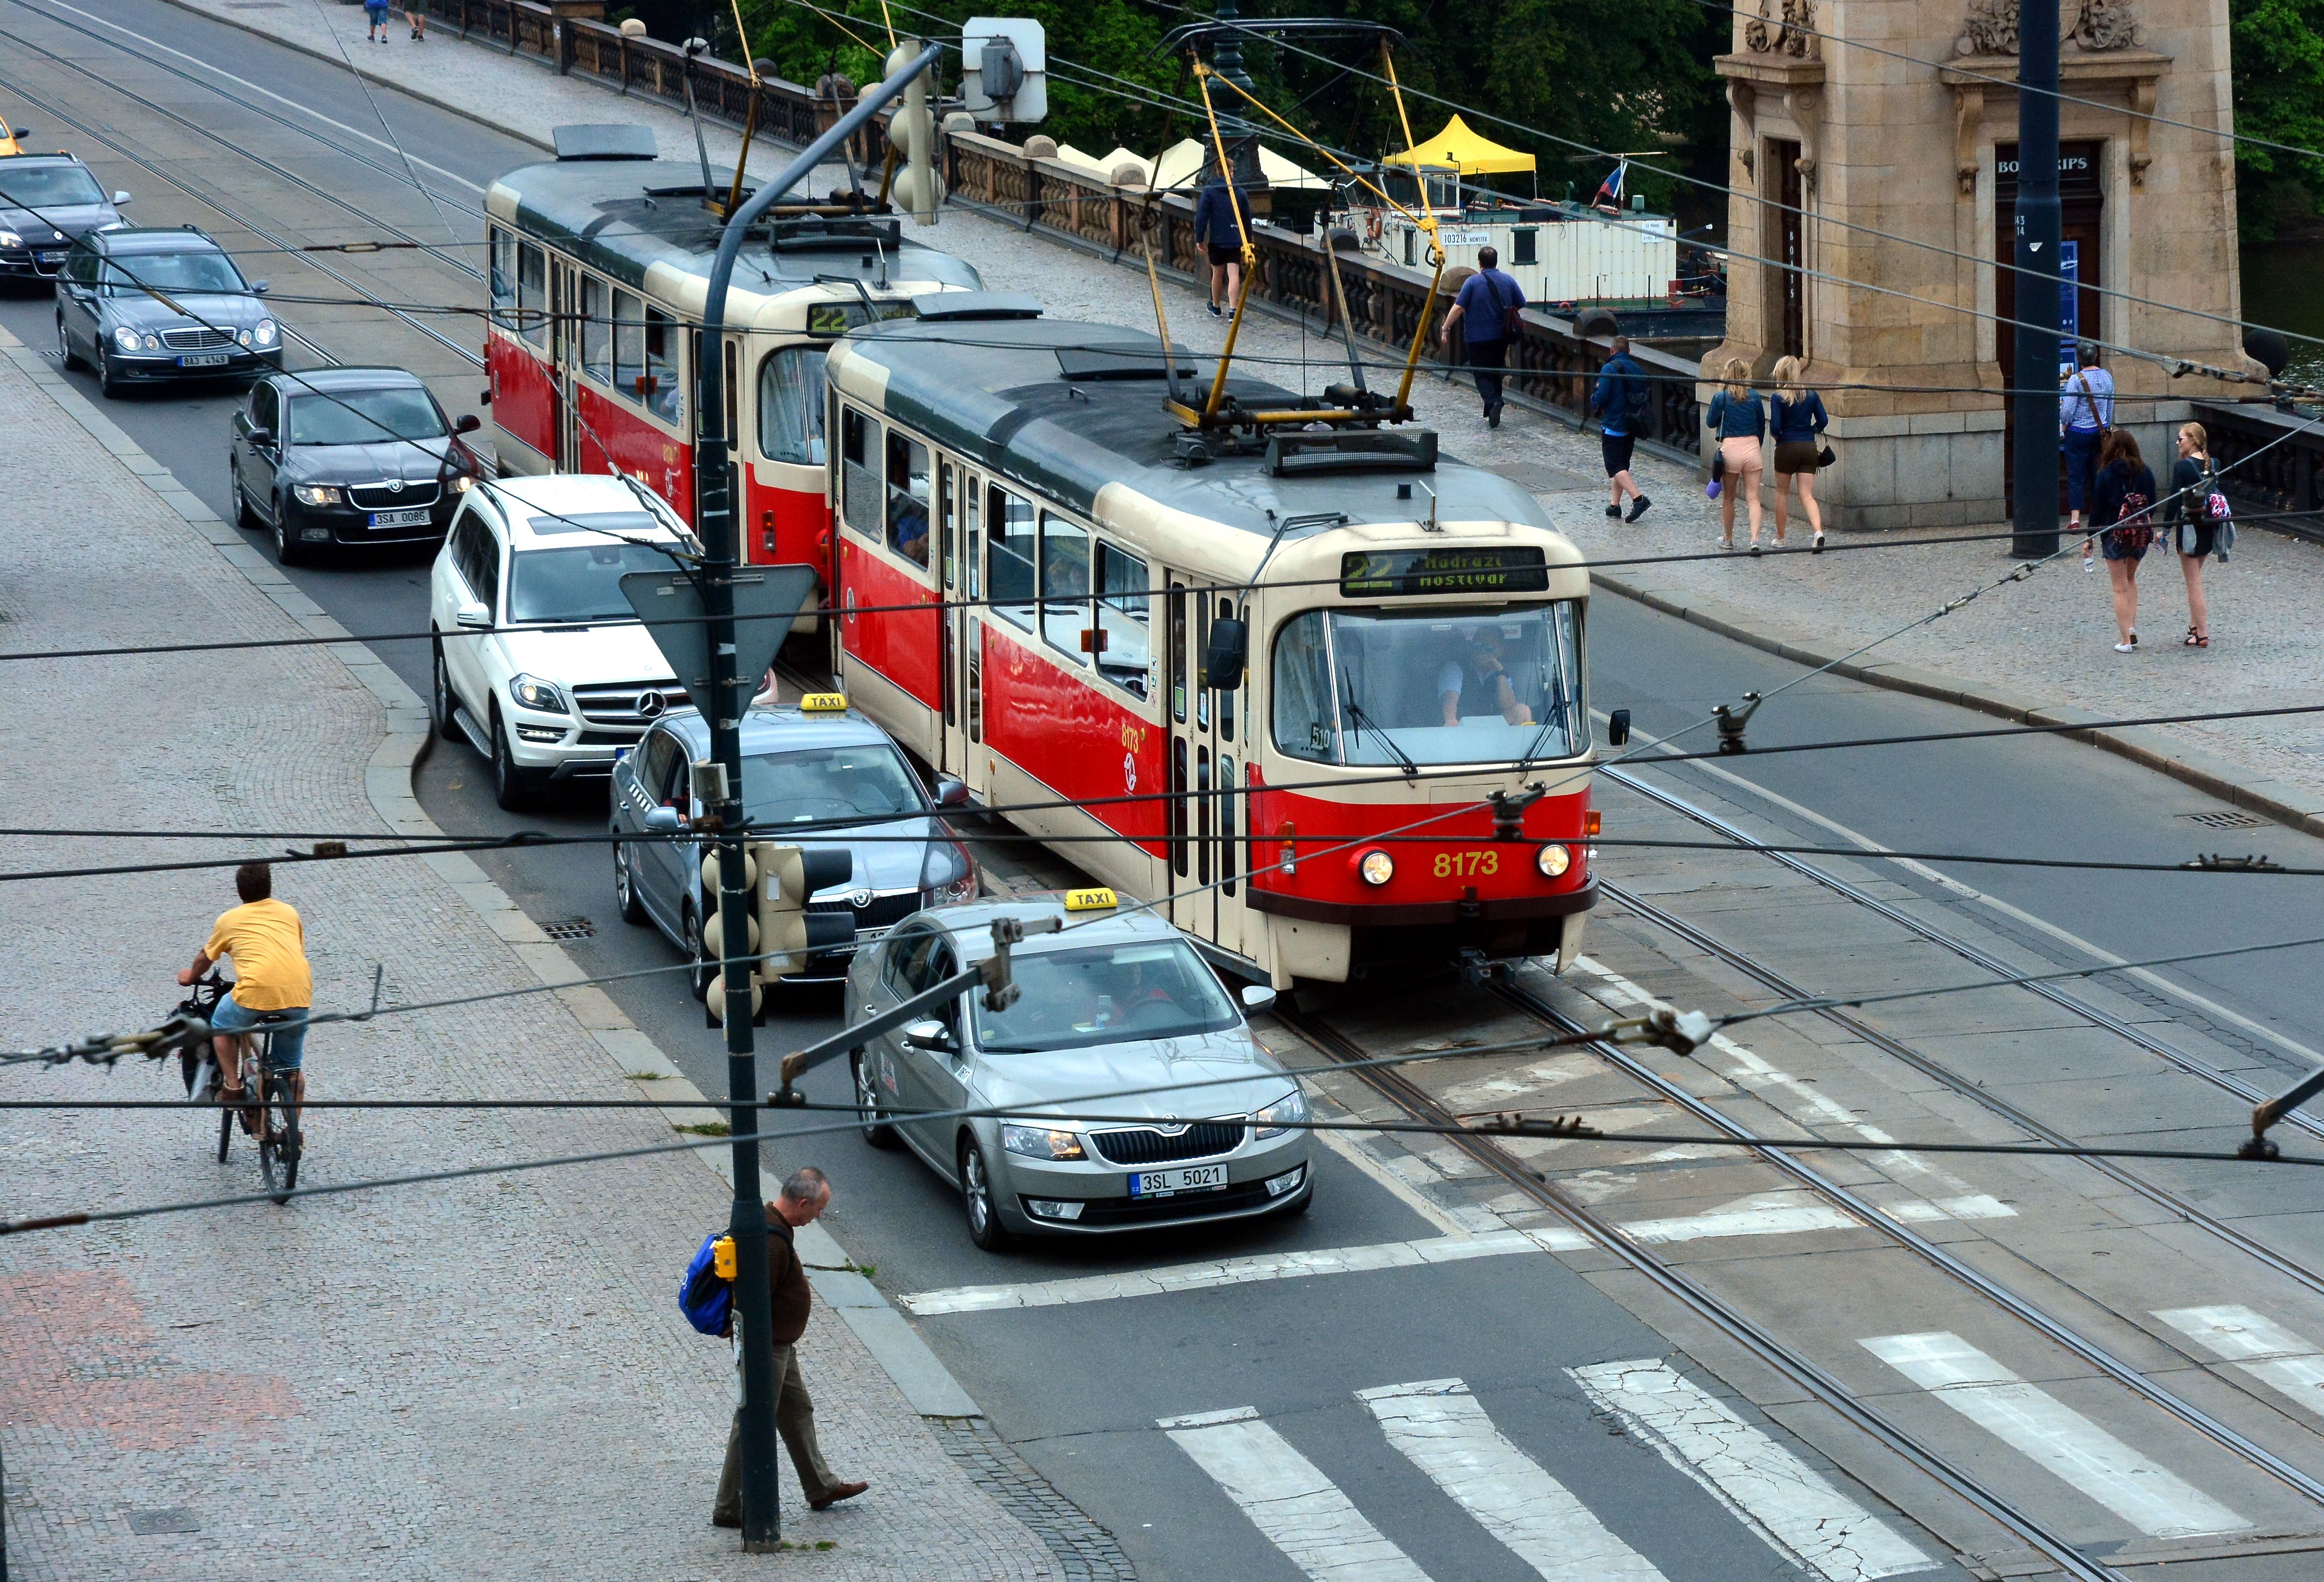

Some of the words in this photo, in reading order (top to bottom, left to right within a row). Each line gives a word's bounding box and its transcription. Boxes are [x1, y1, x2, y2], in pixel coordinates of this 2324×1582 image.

[1444, 234, 1467, 243] 103216
[812, 306, 848, 331] 22
[184, 356, 199, 365] 8A3
[377, 514, 395, 524] 3SA
[402, 511, 425, 522] 0086
[1346, 555, 1392, 589] 22
[811, 697, 841, 706] TAXI
[1122, 723, 1138, 754] 8173
[1312, 726, 1330, 748] 510
[1433, 850, 1498, 878] 8173
[1076, 892, 1109, 905] TAXI
[1143, 1174, 1172, 1190] 3SL
[1183, 1167, 1219, 1186] 5021
